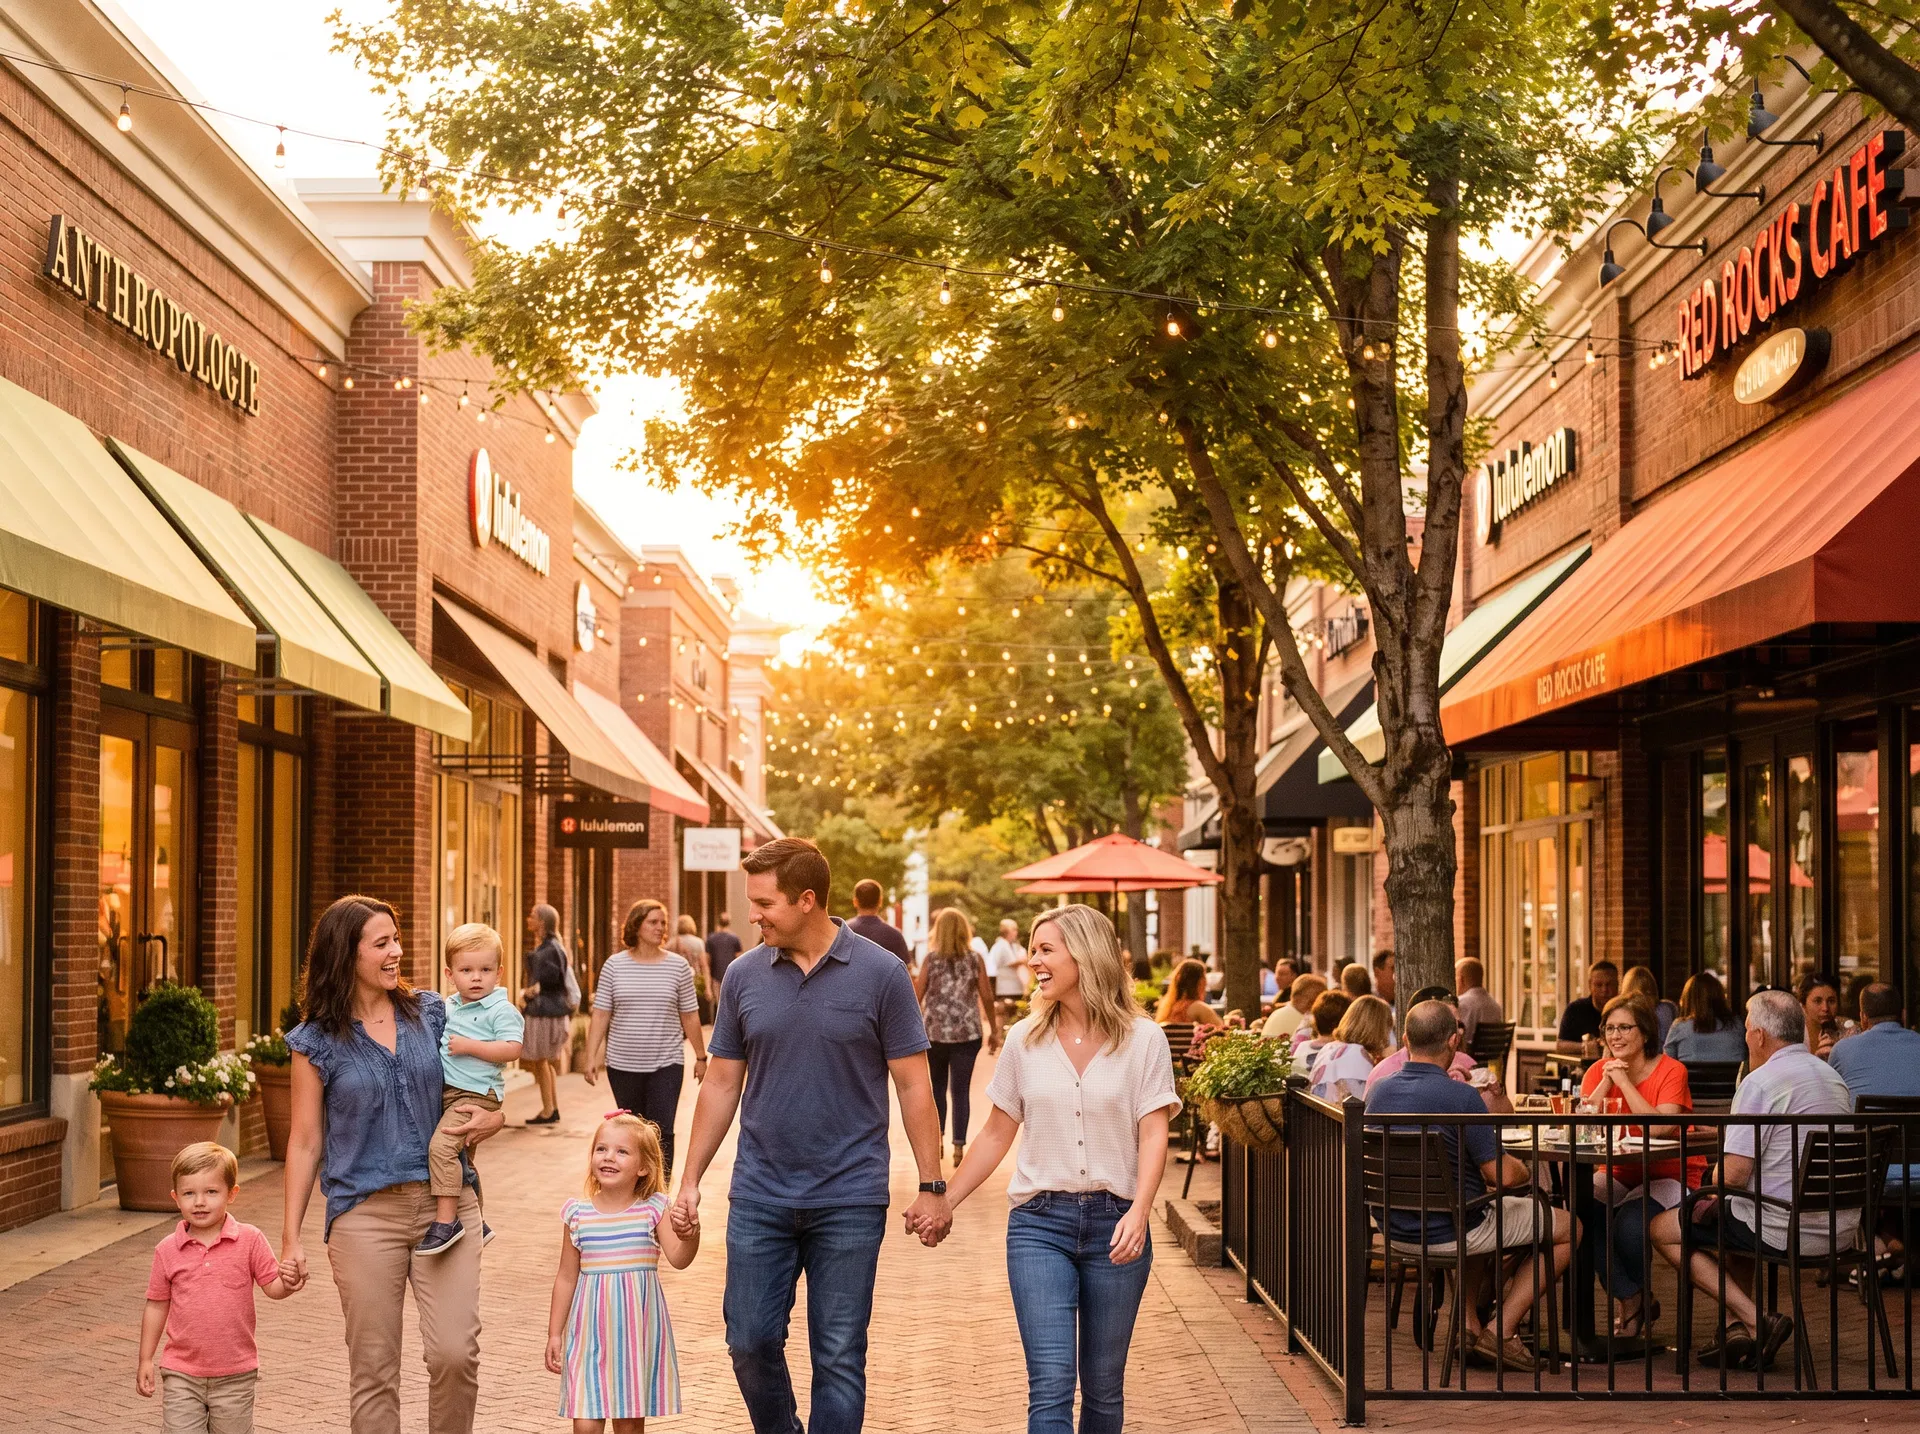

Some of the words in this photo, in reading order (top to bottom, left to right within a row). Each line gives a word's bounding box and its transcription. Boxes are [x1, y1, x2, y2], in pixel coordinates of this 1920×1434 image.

[1678, 278, 1717, 381] RED
[1721, 202, 1802, 350] ROCKS
[1809, 131, 1889, 279] CAFE
[50, 214, 260, 417] ANTHROPOLOGIE
[493, 472, 550, 578] lululemon
[1493, 426, 1567, 524] lululemon
[1537, 673, 1553, 706] RED
[1554, 661, 1582, 701] ROCKS
[1584, 652, 1606, 689] CAFE
[580, 818, 645, 833] lululemon
